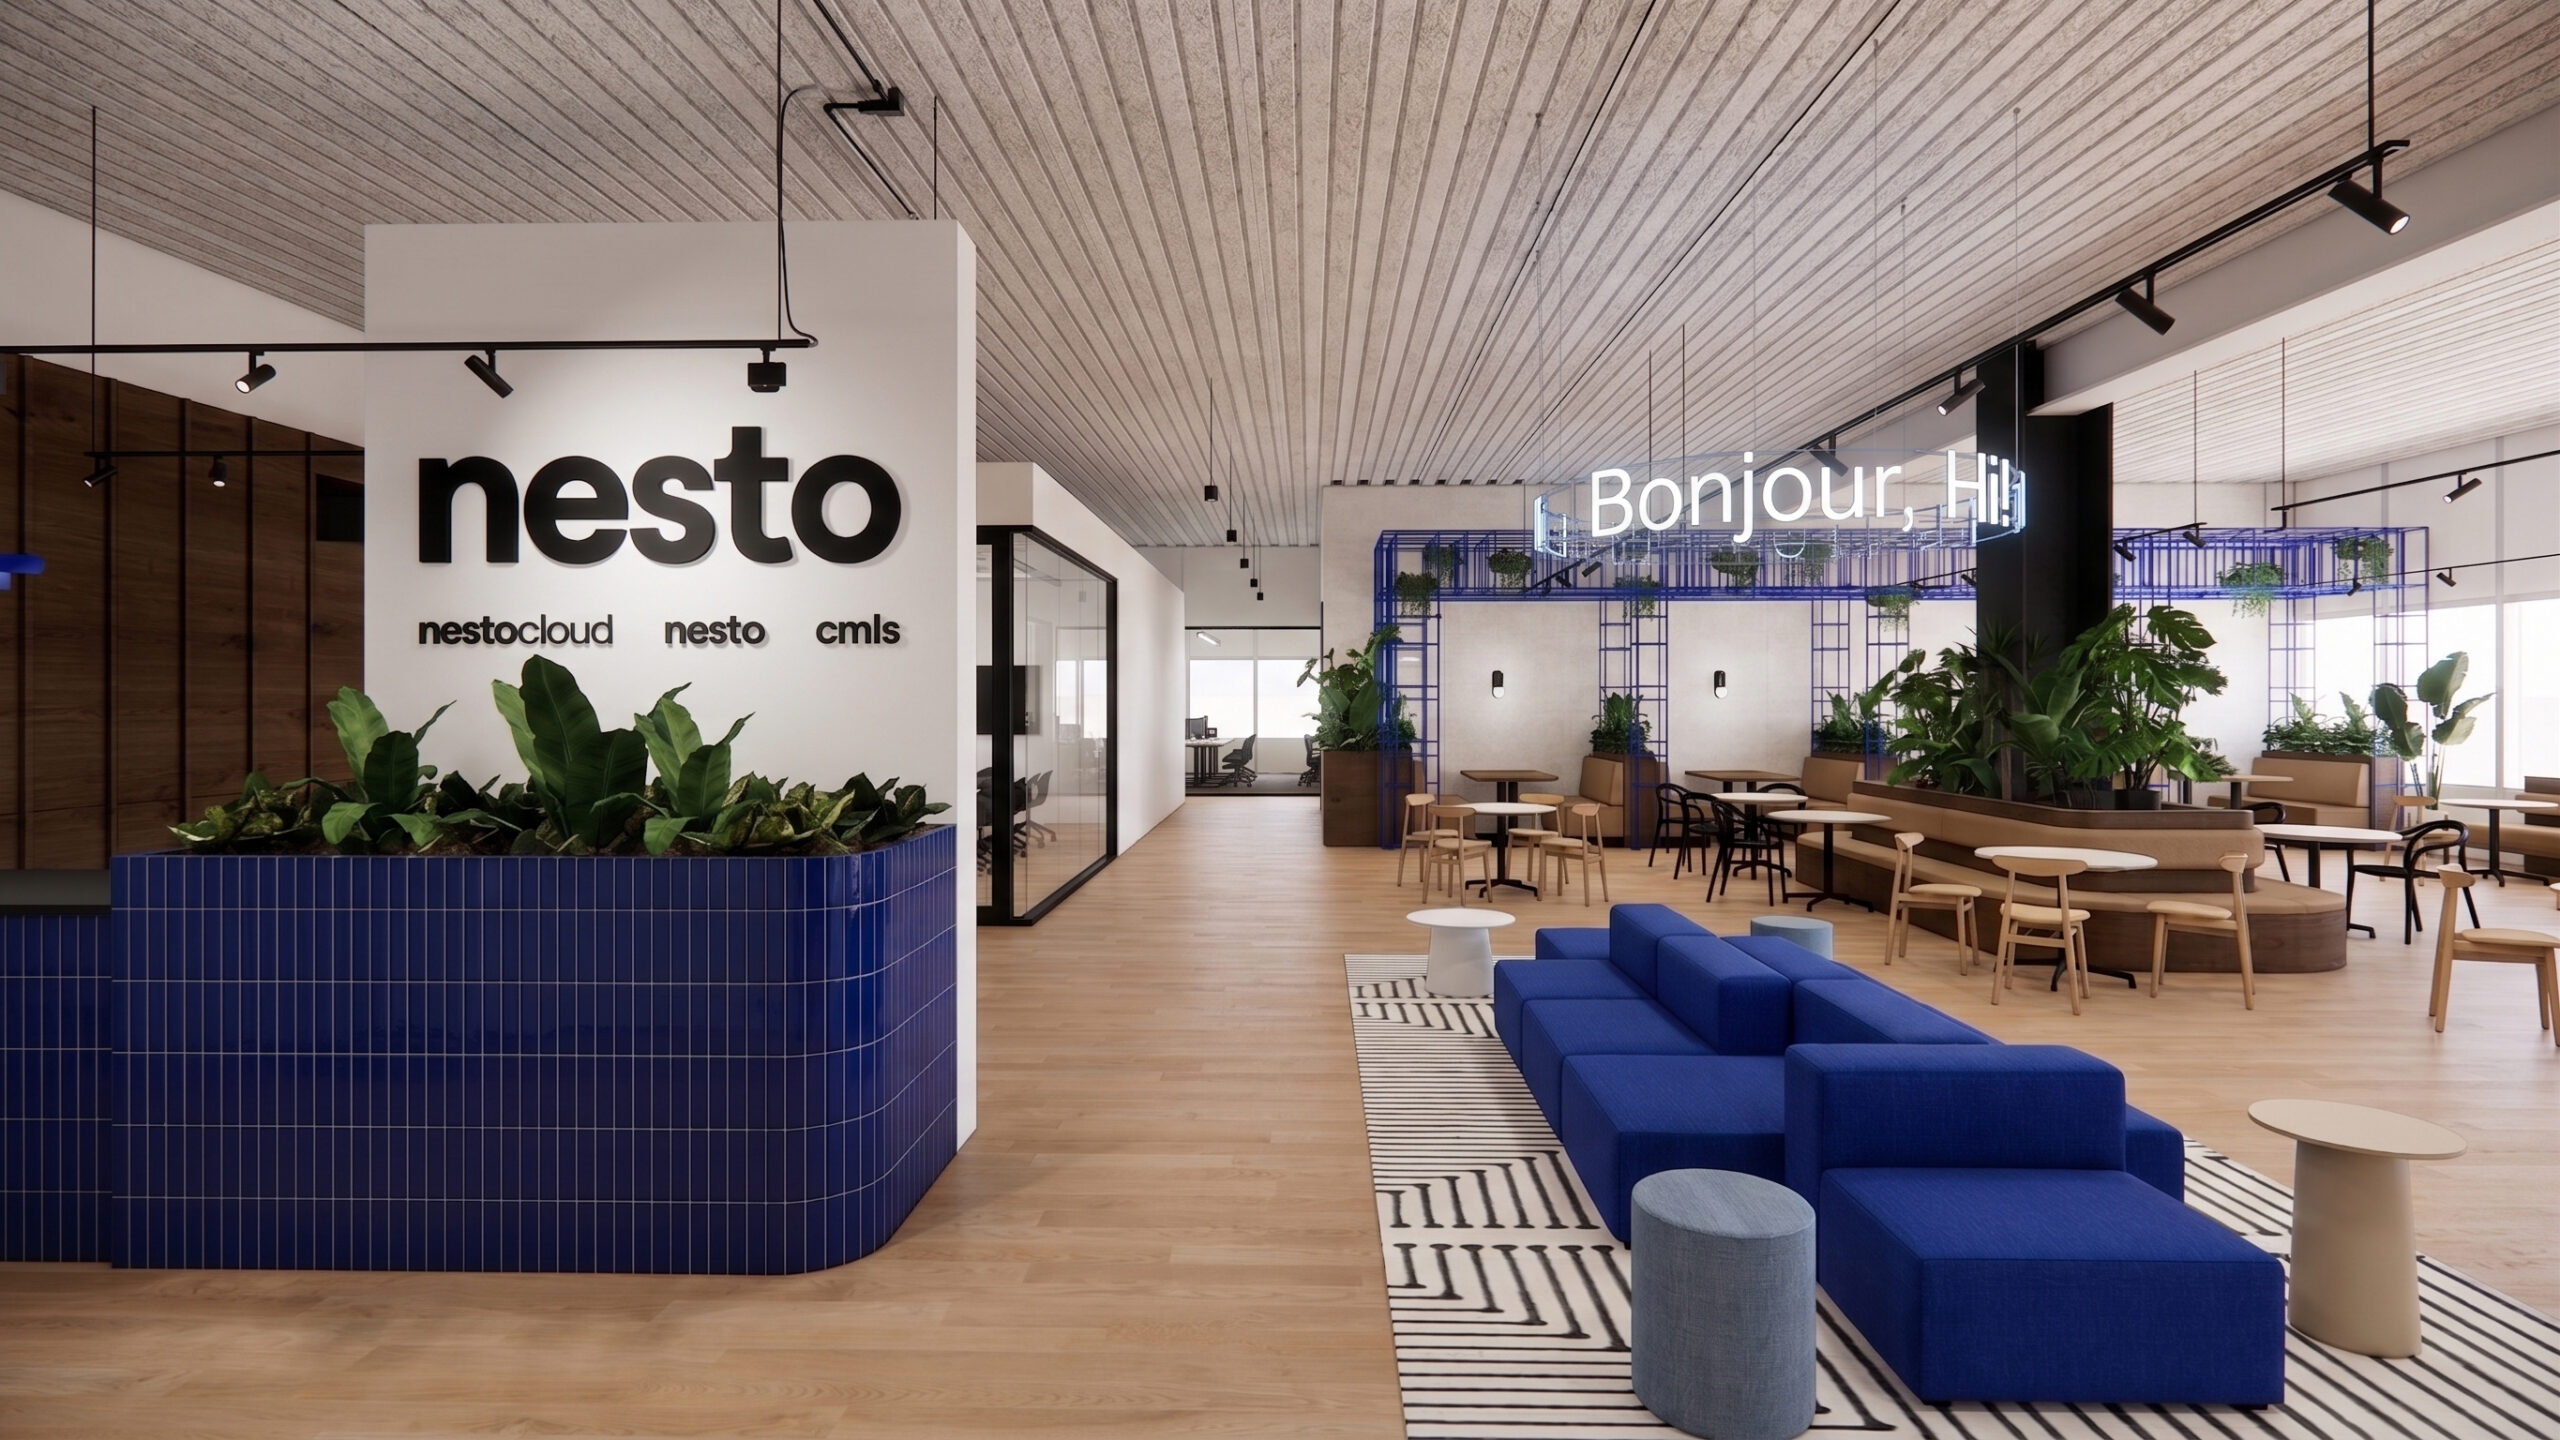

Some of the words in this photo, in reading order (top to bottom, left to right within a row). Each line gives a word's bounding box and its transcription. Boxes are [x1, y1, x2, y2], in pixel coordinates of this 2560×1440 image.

[418, 426, 902, 565] nesto
[1590, 450, 1915, 544] Bonjour,
[1946, 448, 2010, 528] Hi!
[418, 614, 613, 645] nestocloud
[665, 615, 766, 645] nesto
[815, 613, 901, 645] cmls
